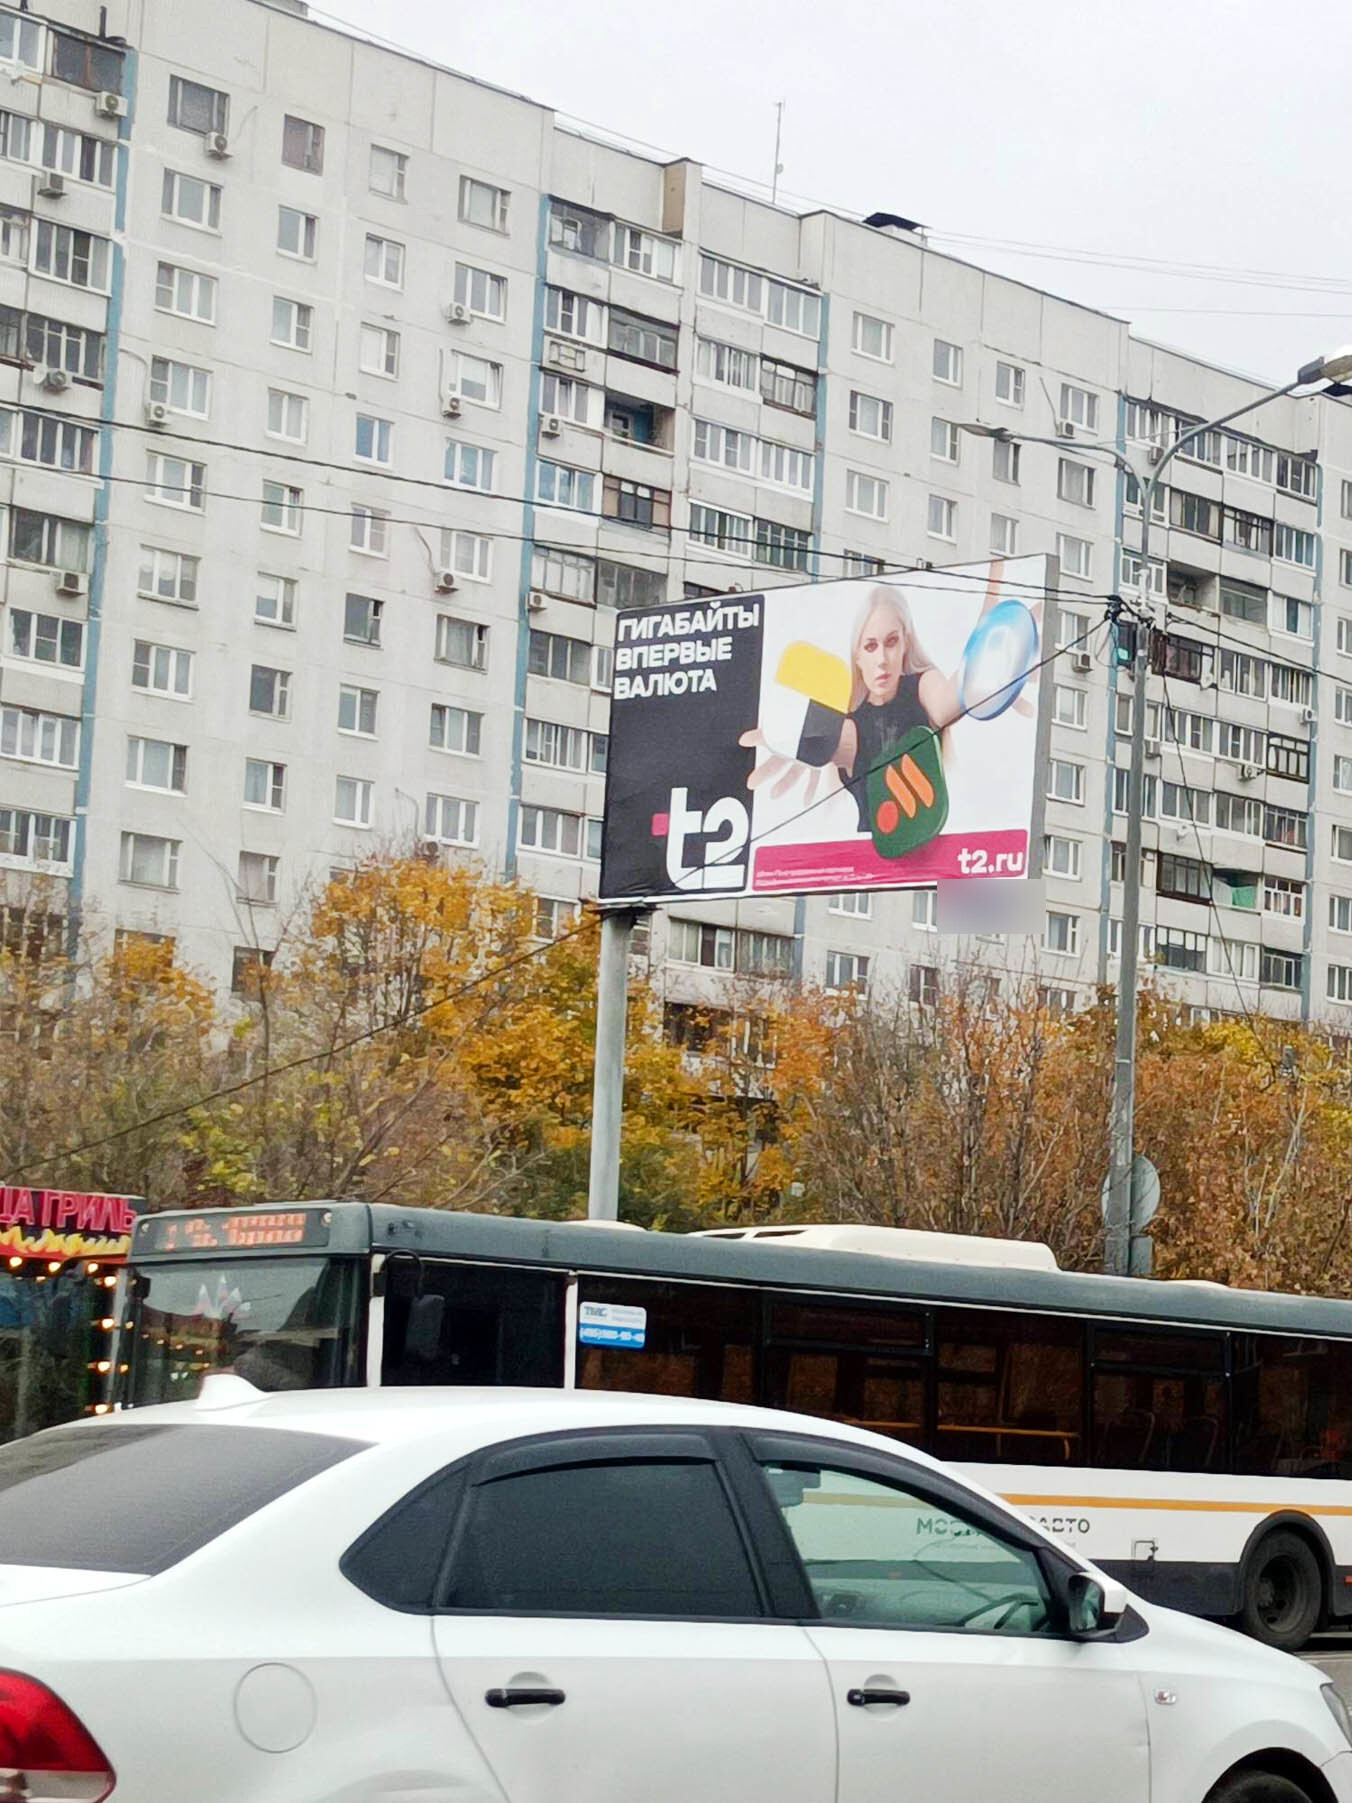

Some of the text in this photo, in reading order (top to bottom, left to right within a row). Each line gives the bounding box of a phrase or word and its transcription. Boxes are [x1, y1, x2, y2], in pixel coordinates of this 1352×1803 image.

[617, 601, 760, 642] ГИГАБАЙТЫ
[615, 636, 733, 671] ВПЕРВЫЕ
[613, 668, 718, 700] ВАЛЮТА
[652, 787, 750, 891] t2
[957, 846, 1024, 875] t2.ru
[41, 1191, 137, 1233] ГРИЛЬ
